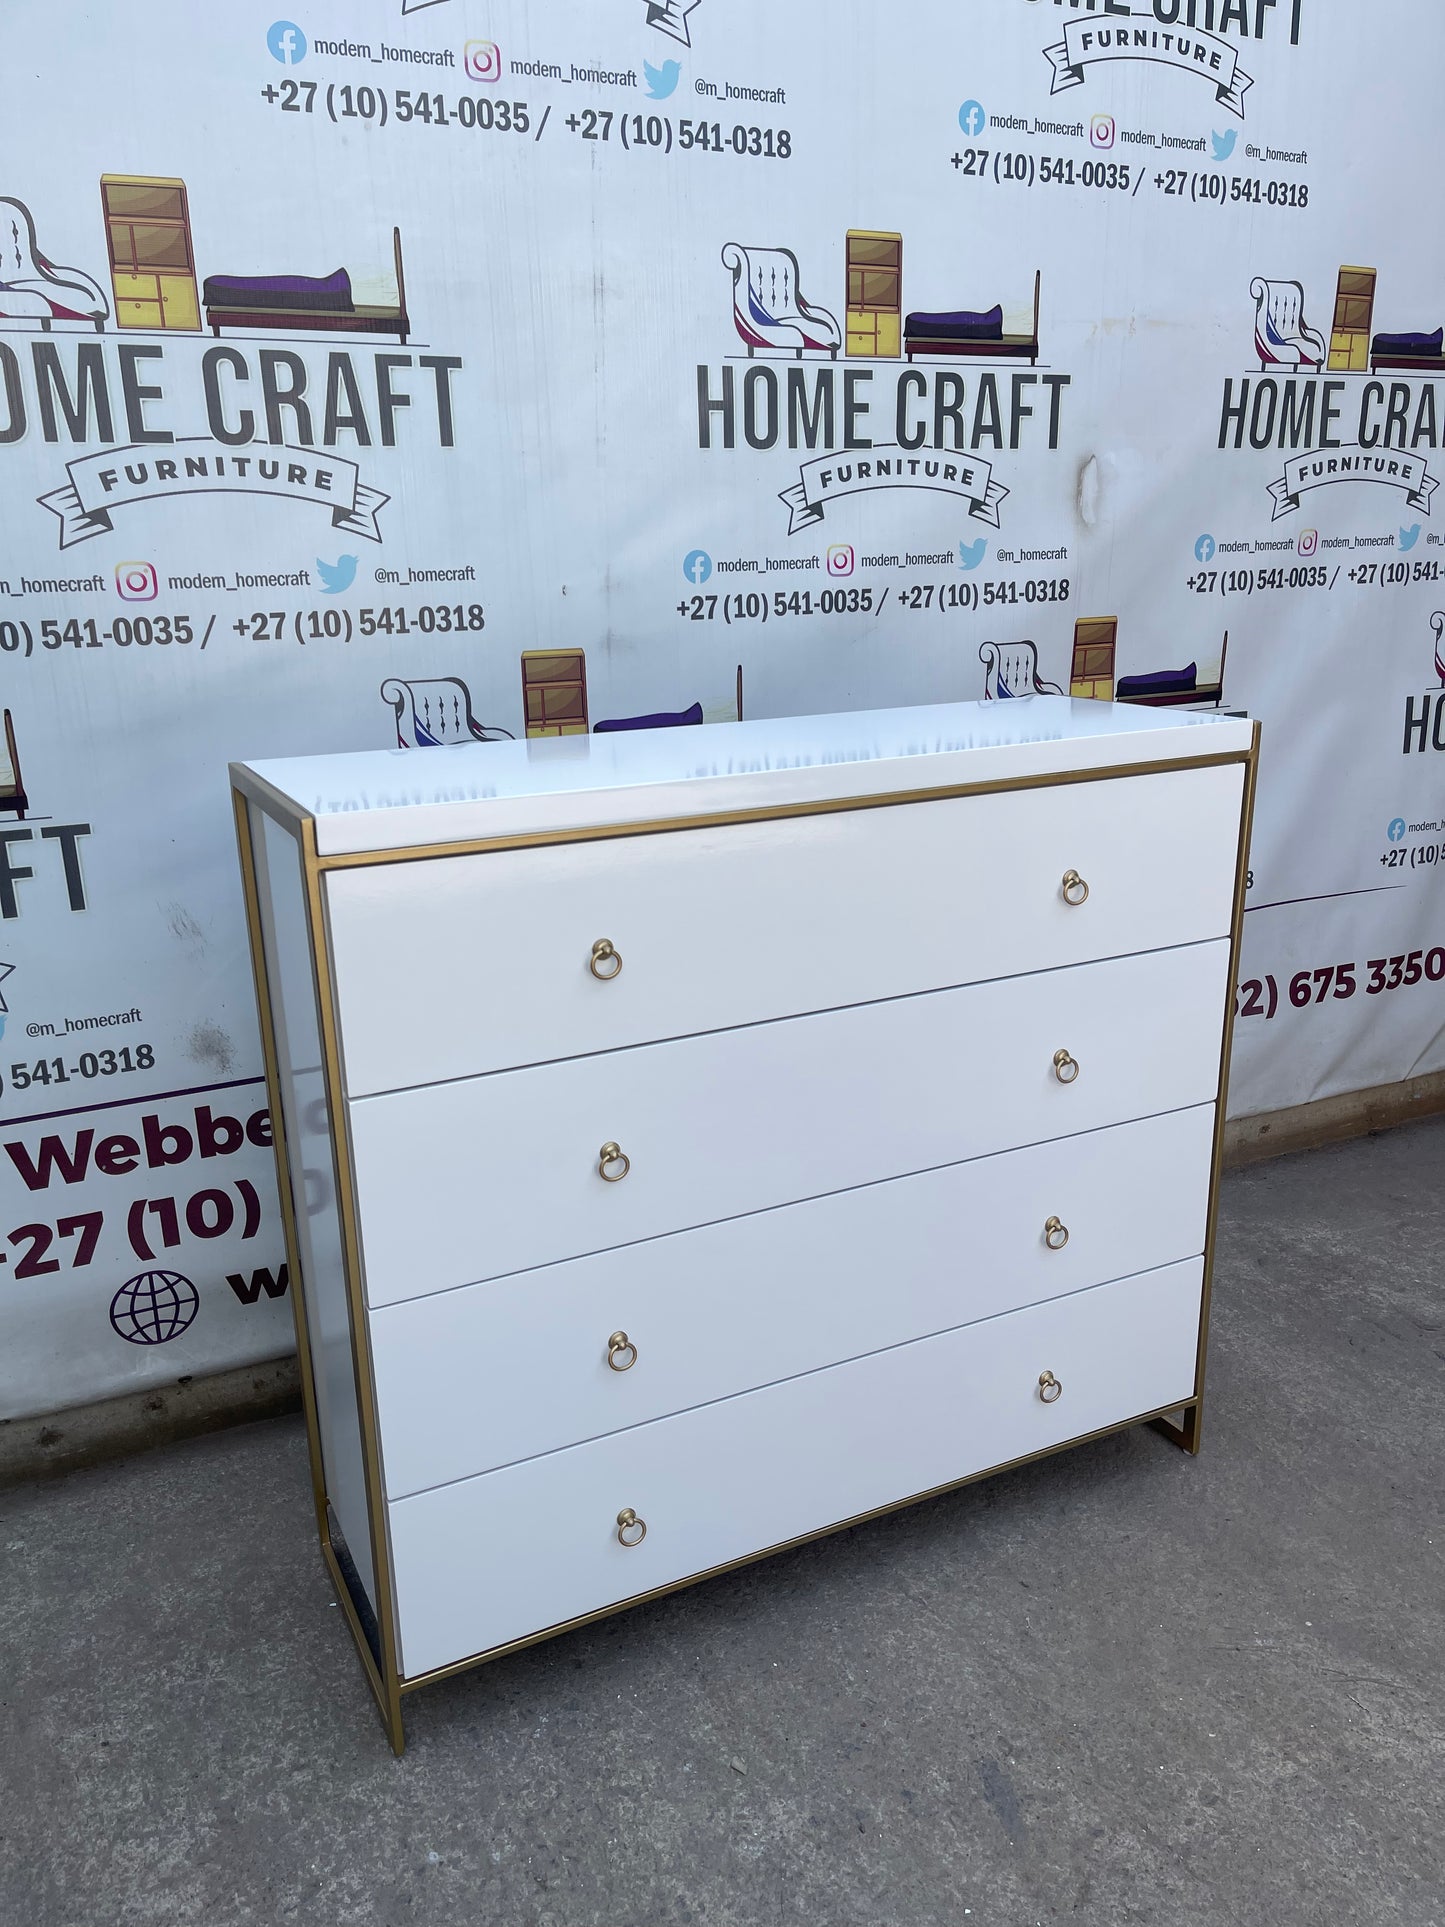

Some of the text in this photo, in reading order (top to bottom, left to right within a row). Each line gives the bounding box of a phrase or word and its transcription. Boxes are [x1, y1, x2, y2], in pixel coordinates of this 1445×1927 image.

[314, 39, 455, 67] modern_homecraft
[694, 78, 786, 104] @m_homecraft
[1082, 29, 1222, 71] FURNITURE
[261, 80, 318, 113] +27
[326, 83, 388, 126] (10)
[395, 90, 530, 133] 541-0035
[565, 110, 613, 142] +27
[620, 113, 673, 154] (10)
[678, 119, 792, 159] 541-0318
[1245, 144, 1308, 165] @m_homecraft
[951, 149, 989, 176] +27
[994, 152, 1035, 186] (10)
[1039, 157, 1130, 190] 541-0035
[1154, 170, 1188, 196] +27
[1191, 173, 1227, 205] (10)
[1230, 177, 1309, 208] 541-0318
[201, 346, 463, 447] CRAFT
[697, 364, 1072, 450] HOME CRAFT
[1217, 378, 1346, 450] HOME
[97, 456, 333, 492] FURNITURE
[820, 459, 975, 489] FURNITURE
[1299, 456, 1413, 482] FURNITURE
[374, 565, 476, 587] @m_homecraft
[996, 547, 1068, 565] @m_homecraft
[676, 595, 718, 621] +27
[723, 592, 769, 624] (10)
[773, 588, 873, 618] 541-0035
[898, 585, 935, 611] +27
[939, 583, 979, 613] (10)
[983, 578, 1070, 606] 541-0318
[1186, 571, 1217, 593] +27
[1221, 570, 1254, 596] (10)
[1257, 566, 1327, 590] 541-0035
[1348, 564, 1378, 584] +27
[1380, 562, 1410, 587] (10)
[41, 615, 194, 649] 541-0035
[232, 611, 287, 642] +27
[293, 608, 353, 645] (10)
[359, 604, 486, 637] 541-0318
[1380, 848, 1407, 868] +27
[1411, 844, 1439, 869] (10)
[1289, 962, 1357, 1008] 675
[1366, 946, 1445, 991] 3350
[26, 1008, 142, 1037] @m_homecraft
[11, 1043, 155, 1090] 541-0318
[3, 1105, 272, 1191] Webbe
[127, 1179, 261, 1262] (10)
